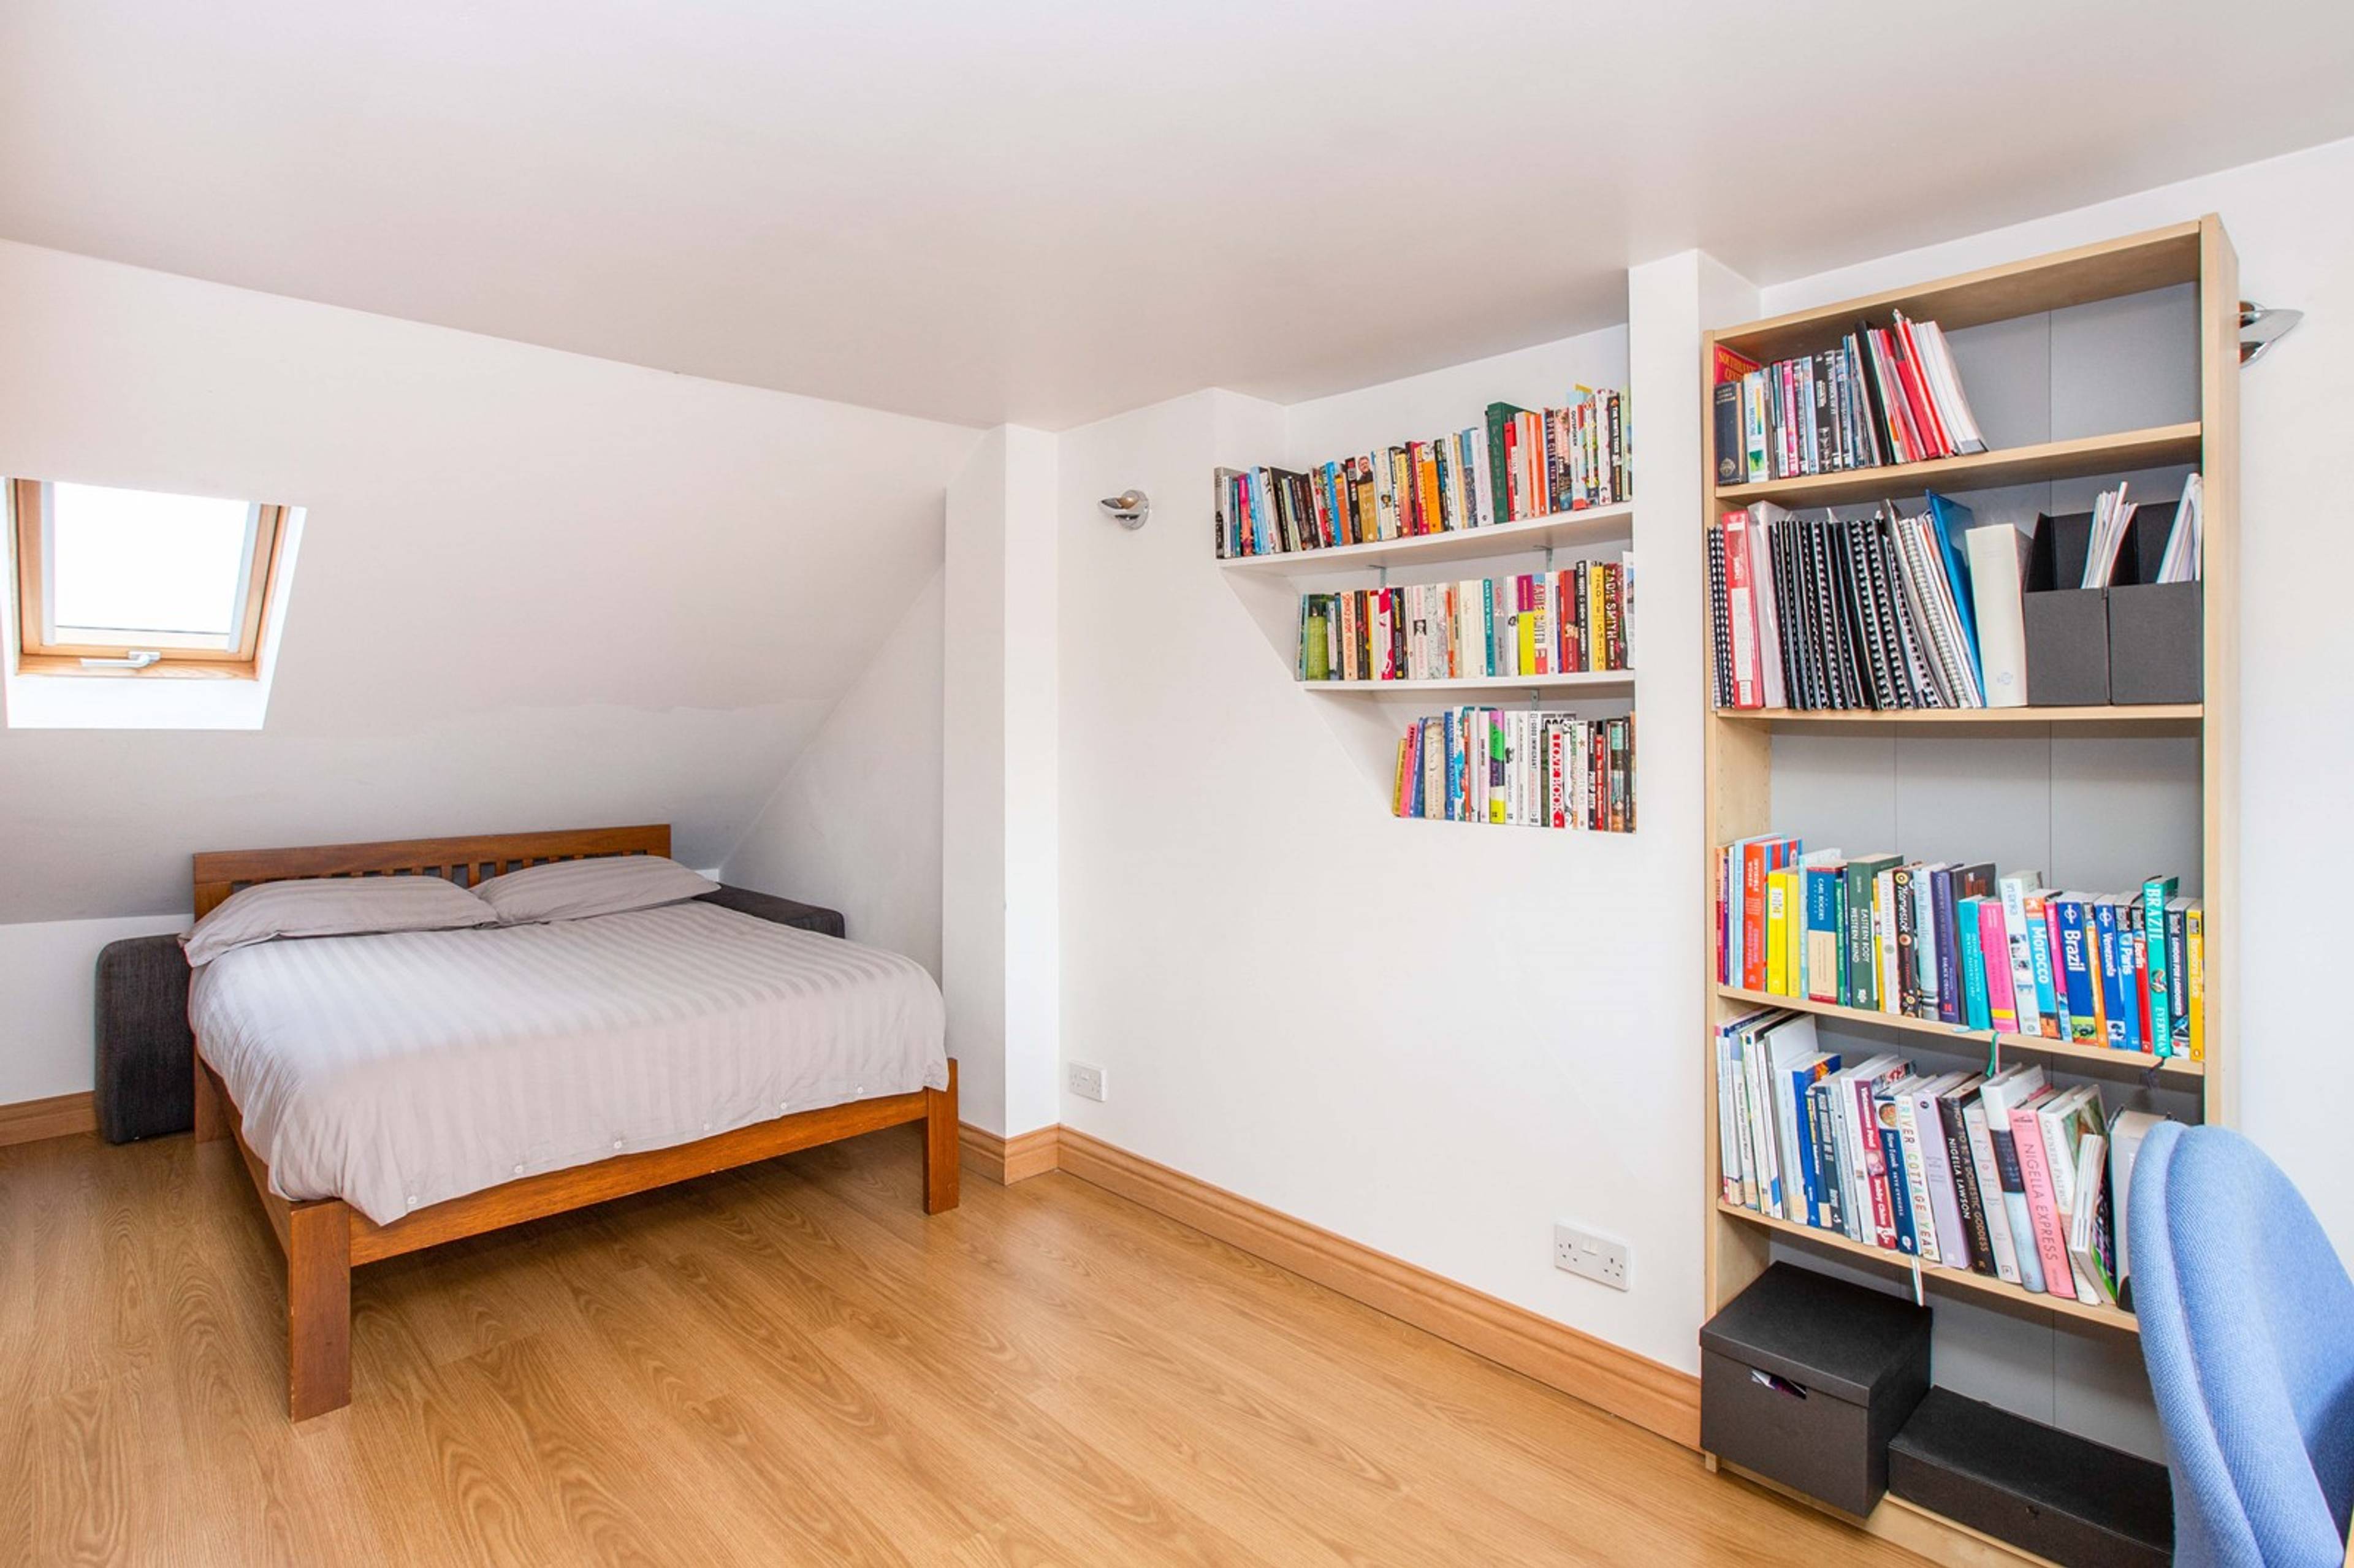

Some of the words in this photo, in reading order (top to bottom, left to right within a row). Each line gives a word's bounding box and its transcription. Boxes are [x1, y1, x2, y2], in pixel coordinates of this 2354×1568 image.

[1491, 425, 1504, 498] PALETTE
[1534, 582, 1545, 610] ZADIE
[1606, 569, 1615, 601] ZADIE
[1606, 603, 1617, 639] SMITH
[1851, 907, 1859, 939] WESTERN
[1898, 886, 1910, 932] Homesick
[2146, 888, 2163, 943] BRAZIL
[1851, 941, 1860, 963] MIND
[2032, 926, 2050, 984] Morocco
[2064, 930, 2085, 972] Brazil
[2102, 932, 2114, 977] Venezuela
[2120, 948, 2132, 975] Paris
[2134, 943, 2145, 969] Berlin
[2171, 937, 2180, 963] LONDON
[2174, 978, 2182, 1016] LONDONERS
[2155, 1006, 2167, 1053] EVERYMAN
[1861, 1087, 1872, 1129] Vietnamese
[1867, 1129, 1876, 1148] Food
[1900, 1106, 1915, 1144] RIVER
[1907, 1152, 1925, 1212] COTTAGE
[1948, 1137, 1961, 1175] NIGELLA
[1956, 1178, 1970, 1220] LAWSON
[1954, 1107, 1962, 1127] HOW
[1958, 1131, 1966, 1143] TO
[1965, 1167, 1980, 1208] DOMESTIC
[1973, 1211, 1988, 1252] GODDESS
[2043, 1119, 2058, 1165] GWYNETH
[2052, 1166, 2068, 1208] PALTROW
[1873, 1179, 1883, 1203] Bobby
[2024, 1143, 2044, 1200] NIGELLA
[2036, 1204, 2058, 1262] EXPRESS
[1919, 1222, 1935, 1257] YEAR
